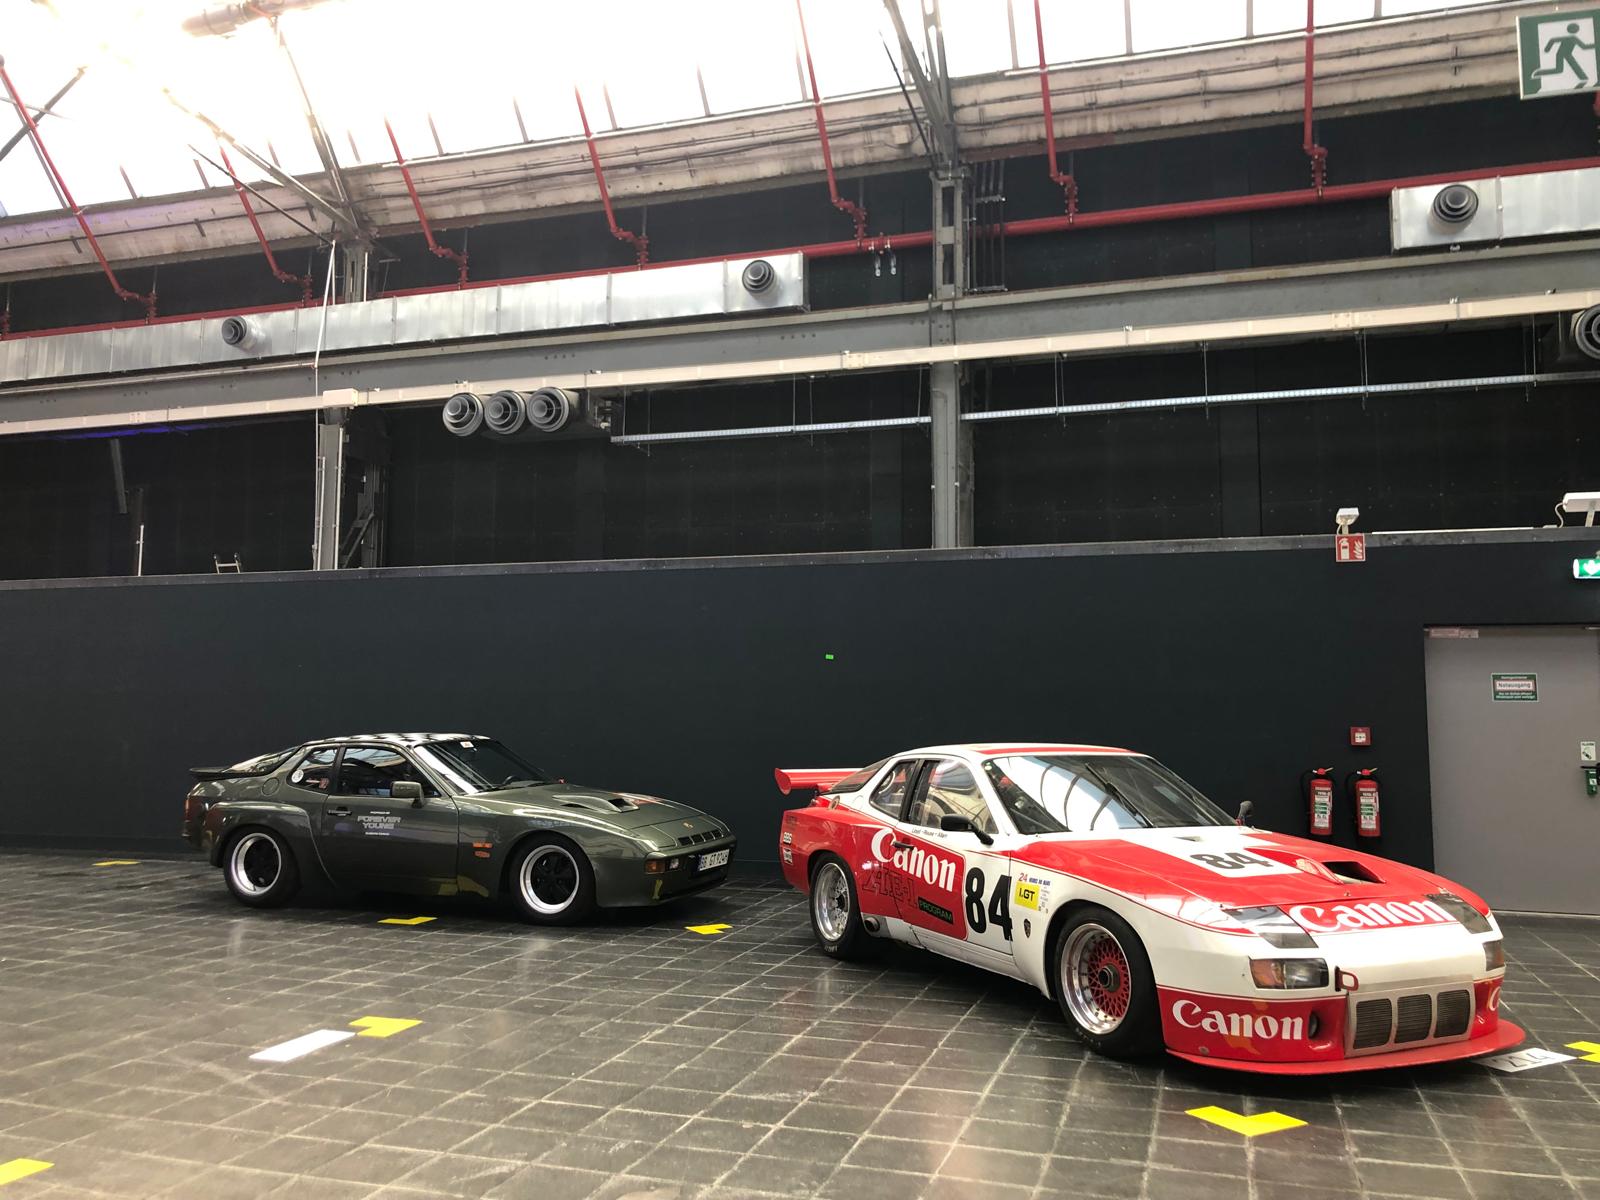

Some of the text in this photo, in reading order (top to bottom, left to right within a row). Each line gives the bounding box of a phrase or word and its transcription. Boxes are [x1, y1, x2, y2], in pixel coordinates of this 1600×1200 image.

[357, 815, 402, 823] FOREVER
[362, 822, 395, 830] YOUNG
[871, 827, 956, 892] Canon
[1190, 852, 1274, 870] 84
[919, 899, 953, 922] PROGRAM
[965, 867, 1013, 941] 84
[1288, 900, 1457, 932] Canon
[1171, 999, 1304, 1041] Canon
